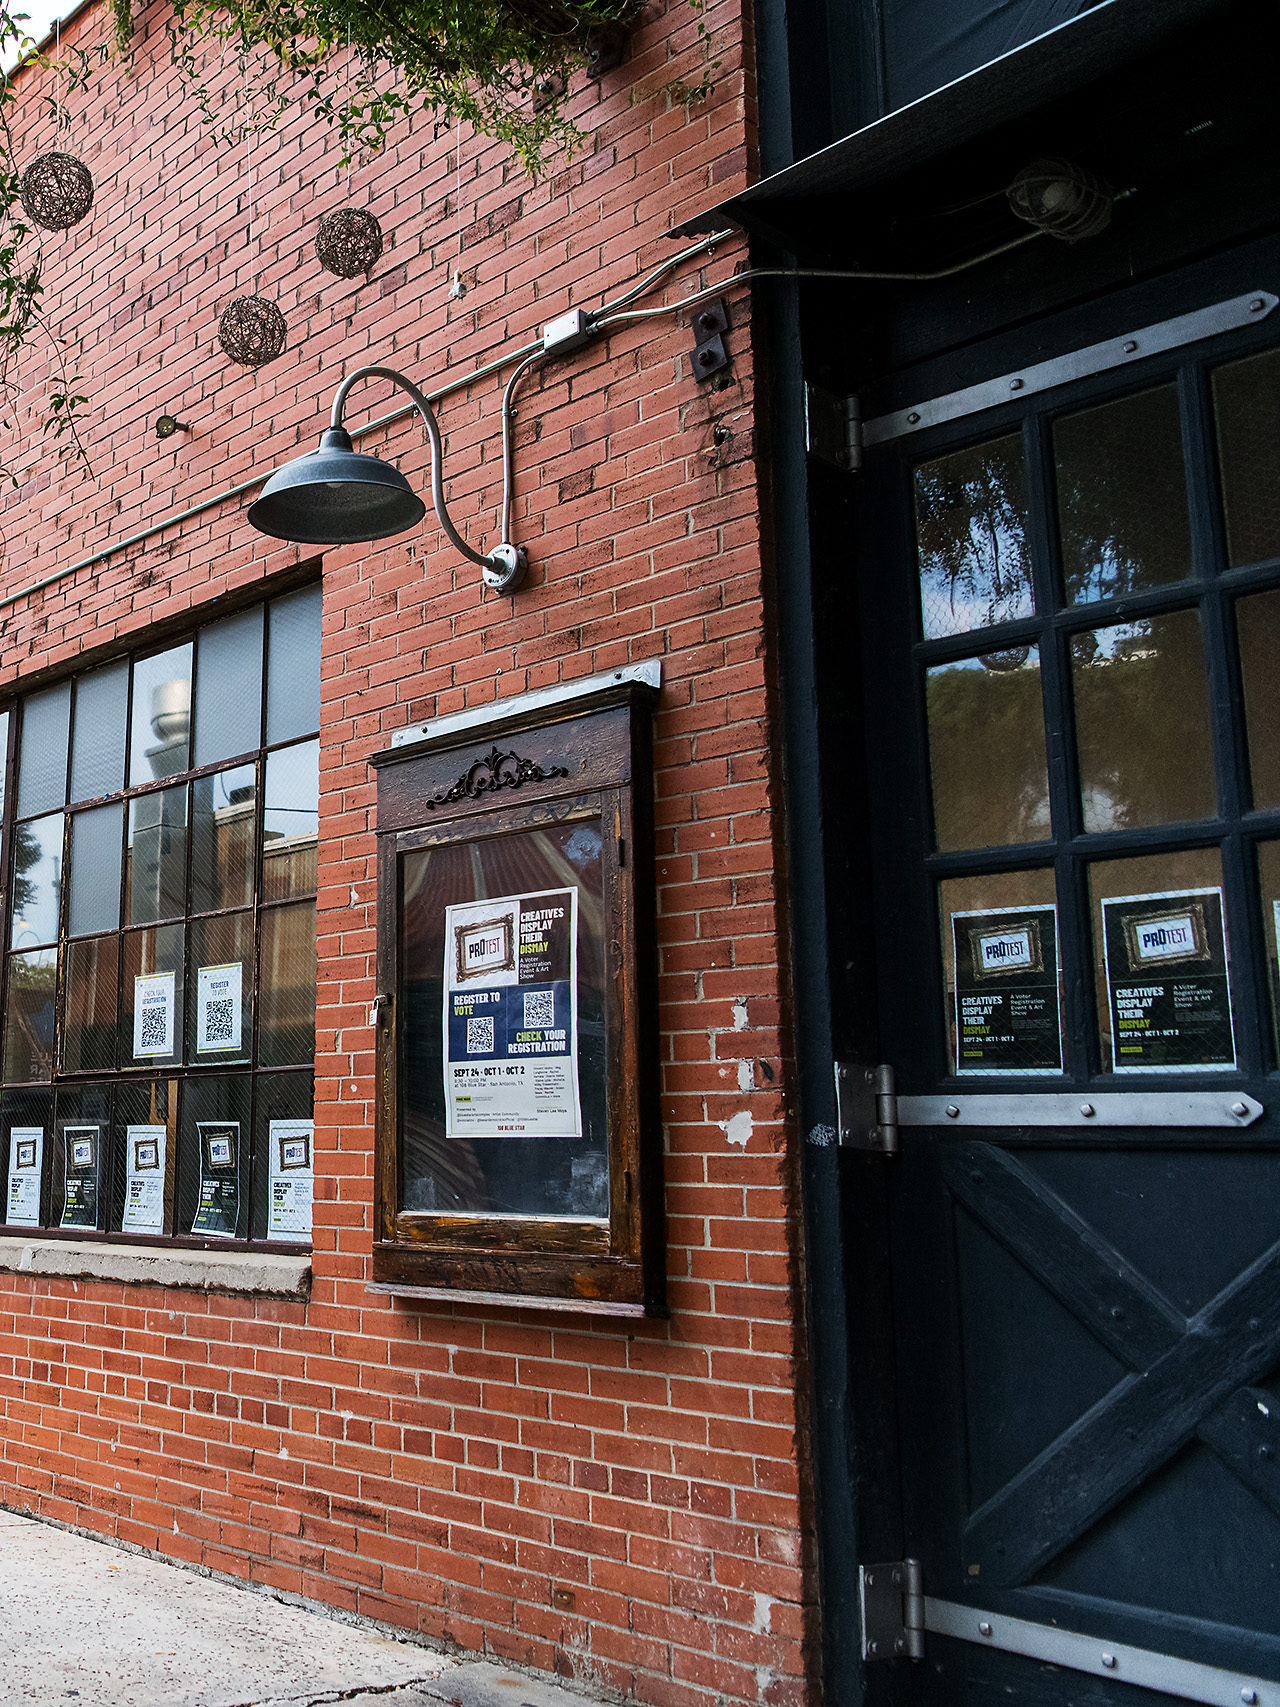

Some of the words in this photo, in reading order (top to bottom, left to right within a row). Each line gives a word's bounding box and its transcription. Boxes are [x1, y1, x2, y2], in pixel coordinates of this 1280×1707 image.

[520, 907, 564, 922] CREATIVES
[520, 920, 552, 933] DISPLAY
[521, 932, 543, 944] THEIR
[1143, 927, 1187, 948] PROTEST
[469, 937, 500, 959] PROTEST
[520, 942, 549, 955] DISMAY
[986, 941, 1024, 959] PROTEST
[520, 961, 552, 969] Registration
[211, 980, 229, 989] REGISTER
[1116, 987, 1164, 998] CREATIVES
[454, 993, 489, 1006] REGISTER
[490, 992, 500, 1002] TO
[962, 996, 1003, 1006] CREATIVES
[1117, 998, 1153, 1009] DISPLAY
[454, 1005, 474, 1016] VOTE
[962, 1006, 993, 1015] DISPLAY
[1118, 1009, 1144, 1019] THEIR
[963, 1016, 985, 1025] THEIR
[1119, 1019, 1150, 1029] DISMAY
[516, 1031, 542, 1042] CHECK
[544, 1029, 566, 1040] YOUR
[963, 1026, 990, 1034] DISMAY
[508, 1041, 566, 1054] REGISTRATION
[454, 1068, 470, 1077] SEPT
[471, 1068, 479, 1077] 24
[484, 1067, 497, 1076] OCT
[506, 1066, 519, 1075] OCT
[521, 1066, 525, 1075] 2
